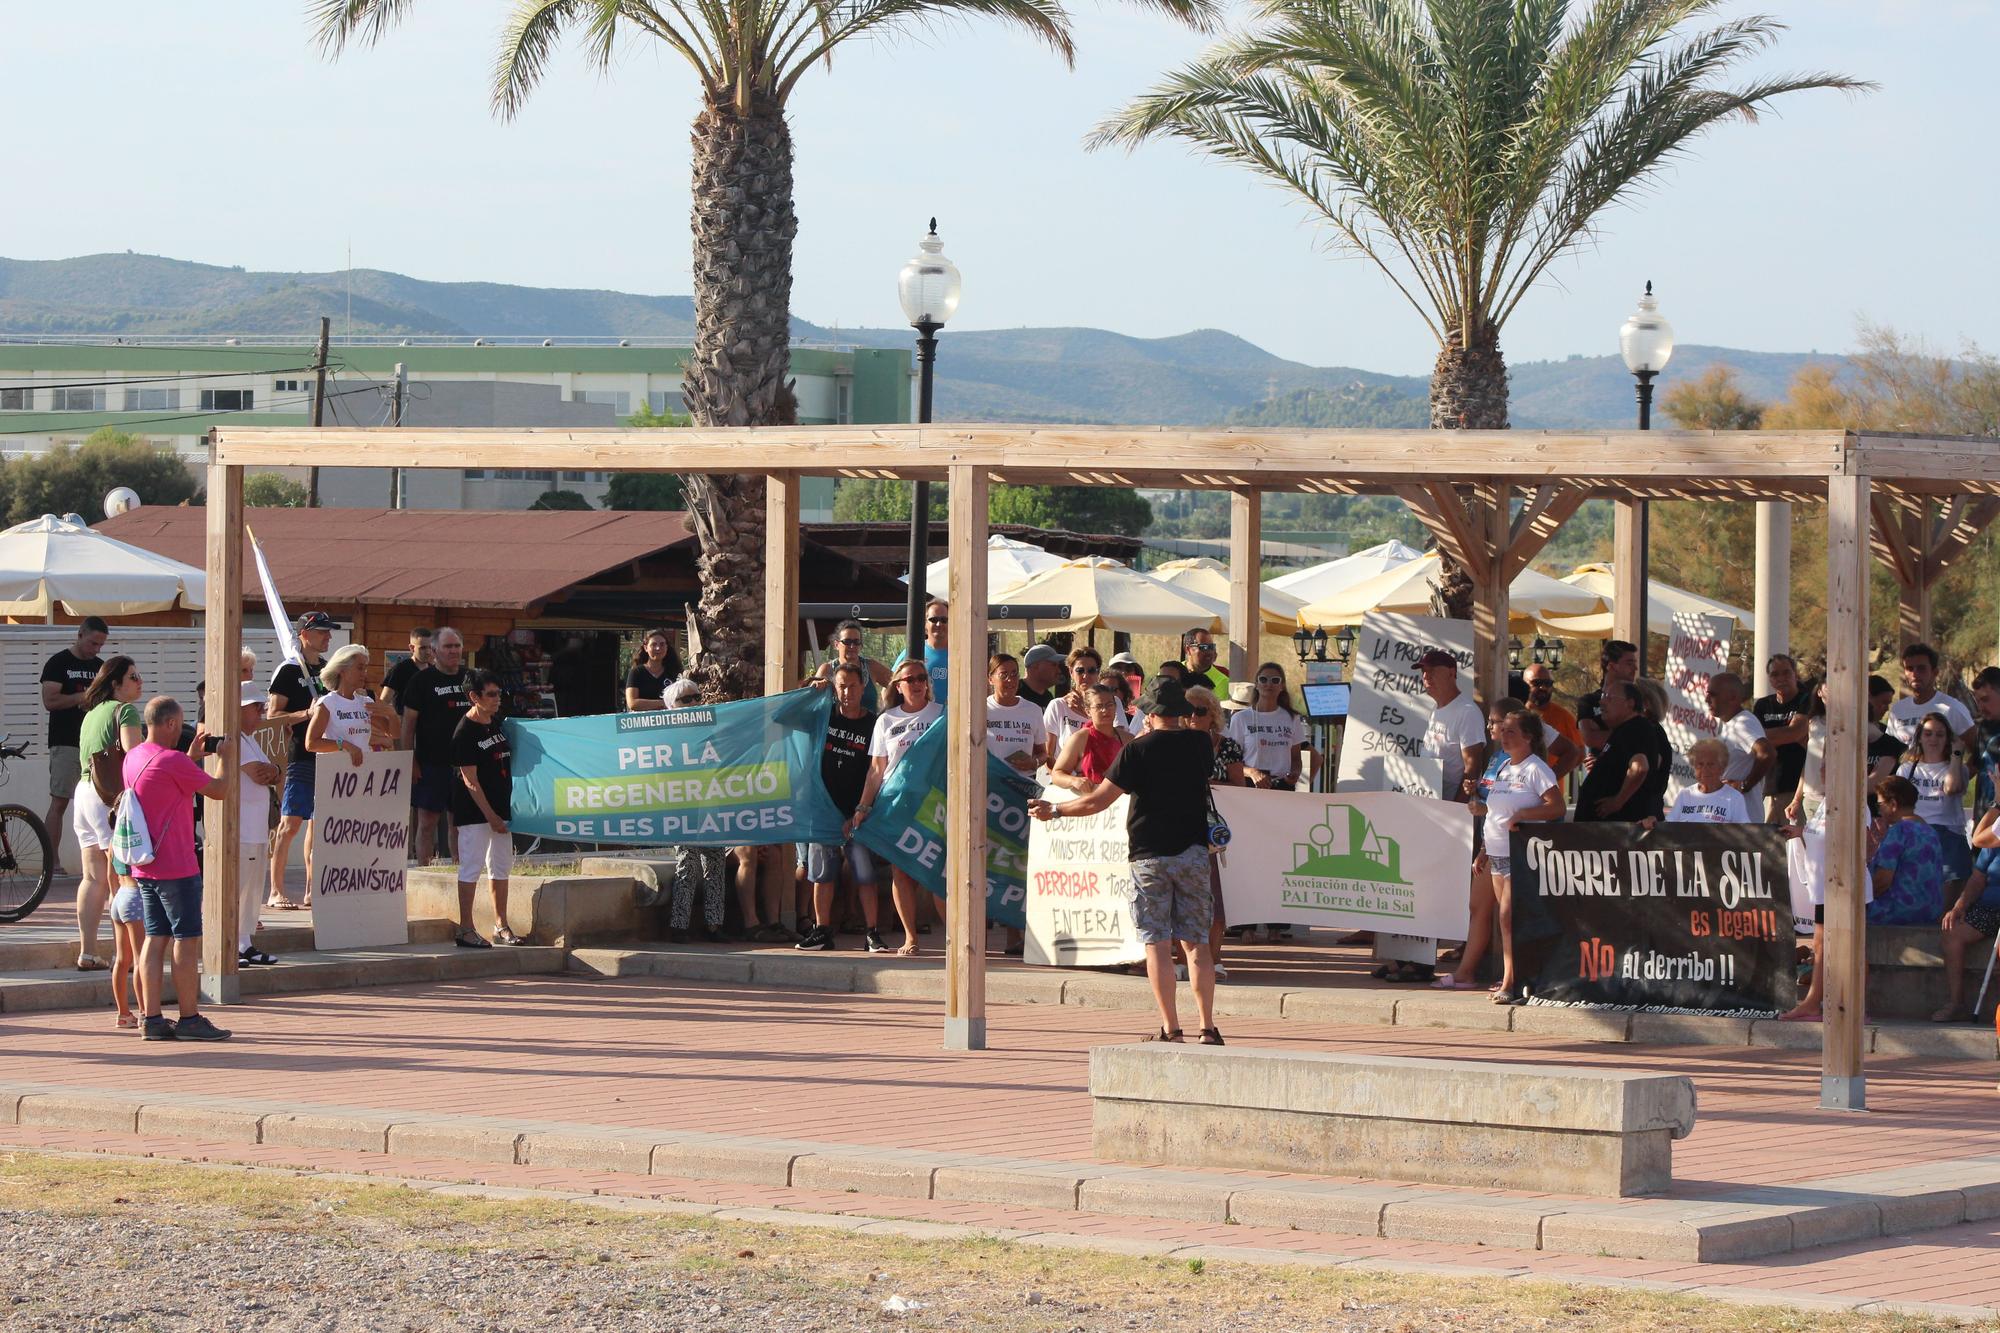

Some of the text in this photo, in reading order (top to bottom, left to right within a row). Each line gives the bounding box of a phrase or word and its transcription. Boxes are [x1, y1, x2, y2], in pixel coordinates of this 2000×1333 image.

[1373, 638, 1389, 661] LA
[620, 711, 713, 730] SOMMEDITERRANIA
[1379, 705, 1405, 726] ES
[1672, 703, 1718, 738] DERRIBAR
[618, 740, 722, 770] PER LA
[332, 767, 399, 799] NO A LA
[566, 767, 778, 809] REGENERACIÓ
[555, 804, 795, 837] DE LES PLATGES
[895, 826, 943, 870] DE
[1034, 870, 1101, 898] DERRIBAR
[1282, 877, 1415, 898] Asociación de Vecinos
[1526, 836, 1772, 910] TORRE DE LA SAL
[1282, 890, 1414, 913] PAI Torre de la Sal
[1052, 907, 1121, 938] ENTERA
[1690, 909, 1711, 937] es
[1621, 950, 1640, 981] al
[1643, 950, 1715, 982] derribo
